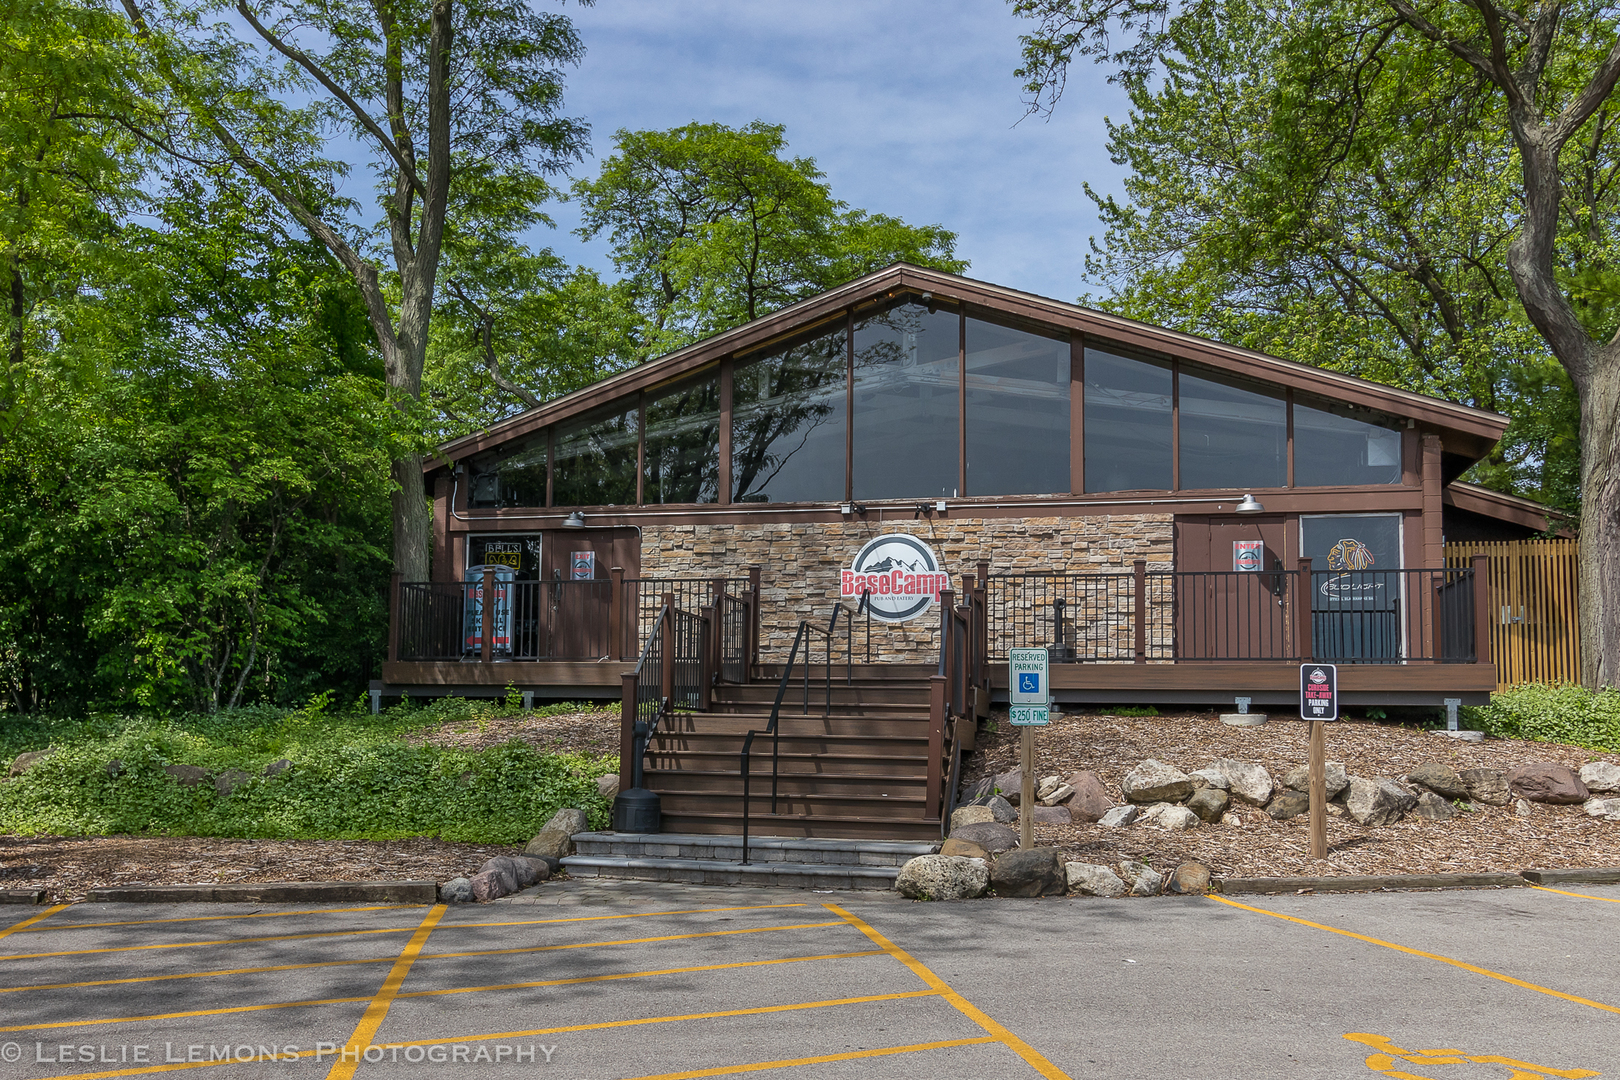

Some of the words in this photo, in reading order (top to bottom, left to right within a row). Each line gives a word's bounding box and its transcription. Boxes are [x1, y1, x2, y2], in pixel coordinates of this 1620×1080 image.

[488, 544, 519, 553] BELL'S
[842, 570, 947, 602] BaseCamp
[1305, 691, 1332, 699] TAKE-AWAY
[1308, 699, 1330, 707] PARKING
[1011, 710, 1030, 722] $250
[1032, 710, 1048, 721] FINE
